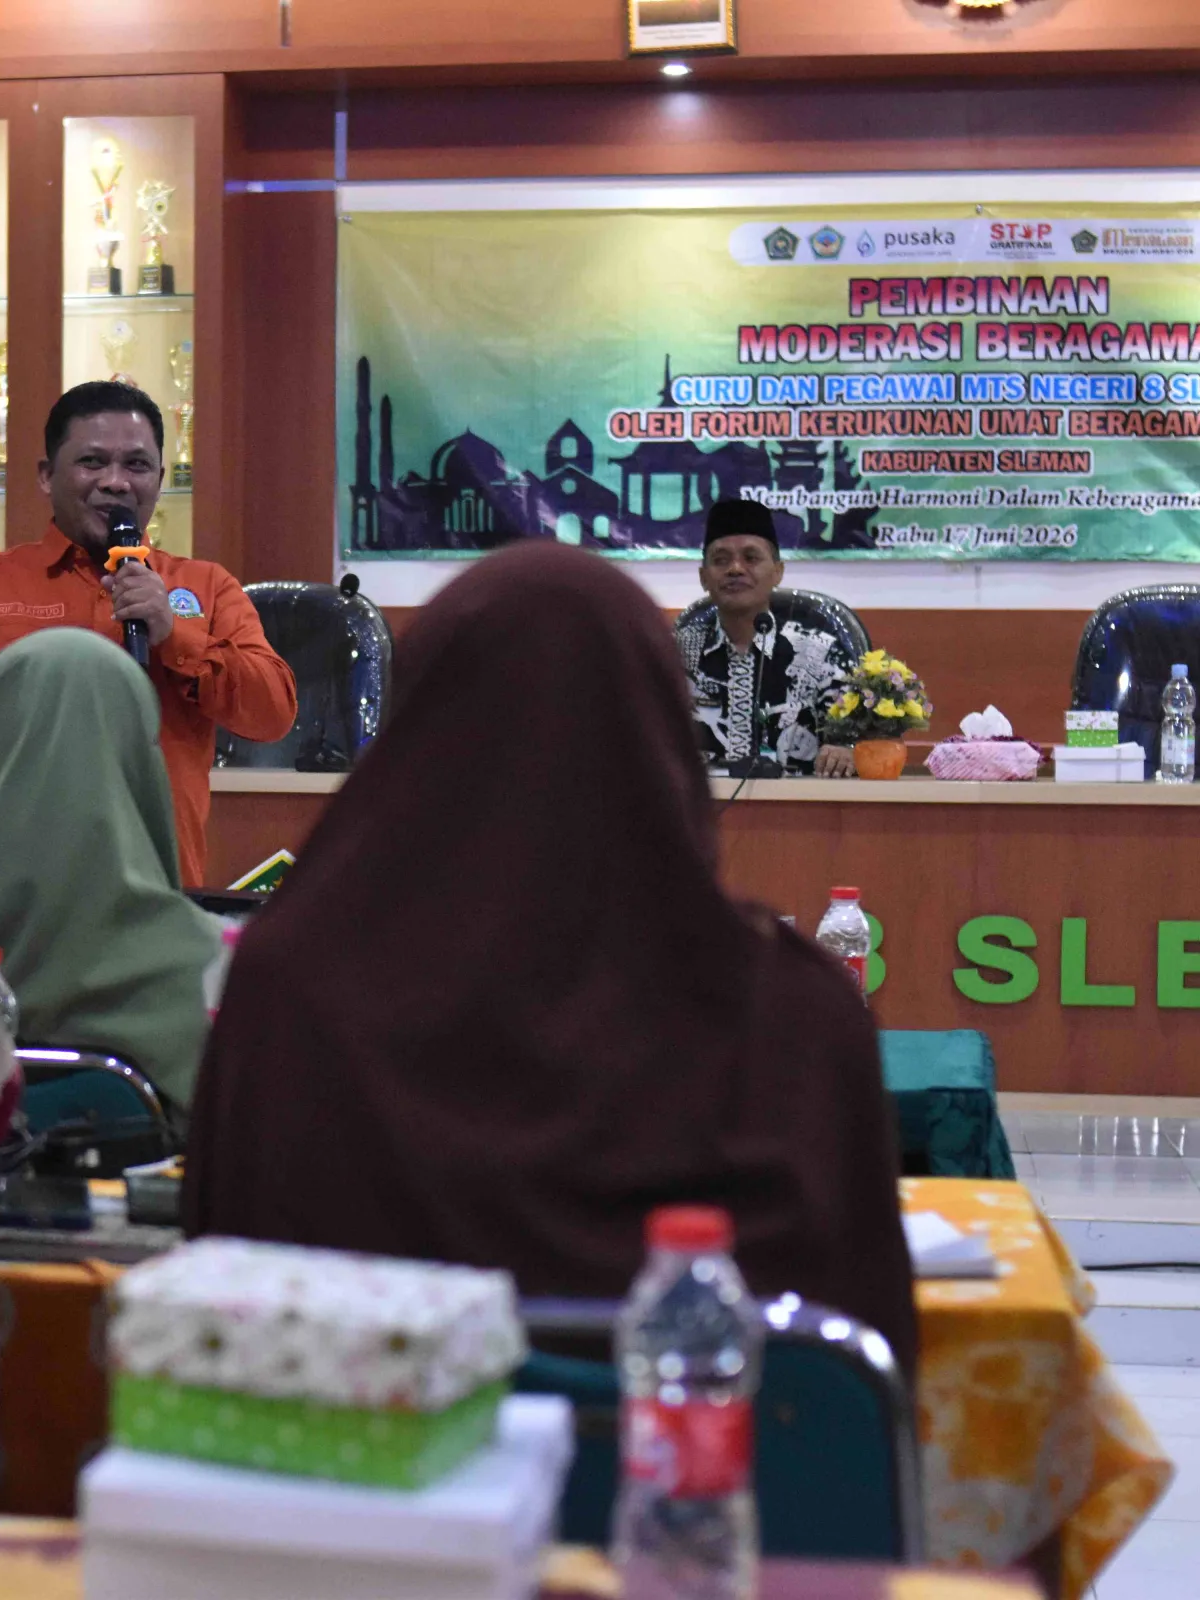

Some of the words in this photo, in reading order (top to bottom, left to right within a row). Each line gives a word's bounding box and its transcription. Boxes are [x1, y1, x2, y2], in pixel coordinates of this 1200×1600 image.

[884, 226, 957, 248] pusaka
[849, 277, 1110, 317] PEMBINAAN
[738, 322, 963, 363] MODERASI
[674, 377, 750, 402] GURU
[760, 376, 817, 402] DAN
[827, 375, 954, 401] PEGAWAI
[963, 375, 1026, 401] MTS
[1031, 375, 1136, 401] NEGERI
[1142, 374, 1164, 401] 8
[610, 411, 684, 438] OLEH
[691, 410, 791, 438] FORUM
[800, 409, 973, 438] KERUKUNAN
[980, 409, 1063, 437] UMAT
[862, 451, 994, 473] KABUPATEN
[997, 451, 1091, 473] SLEMAN
[742, 486, 877, 512] Membangun
[880, 487, 981, 507] Harmoni
[987, 487, 1060, 507] Dalam
[880, 526, 937, 544] Rabu
[974, 526, 1015, 547] Juni
[1020, 526, 1076, 544] 2026
